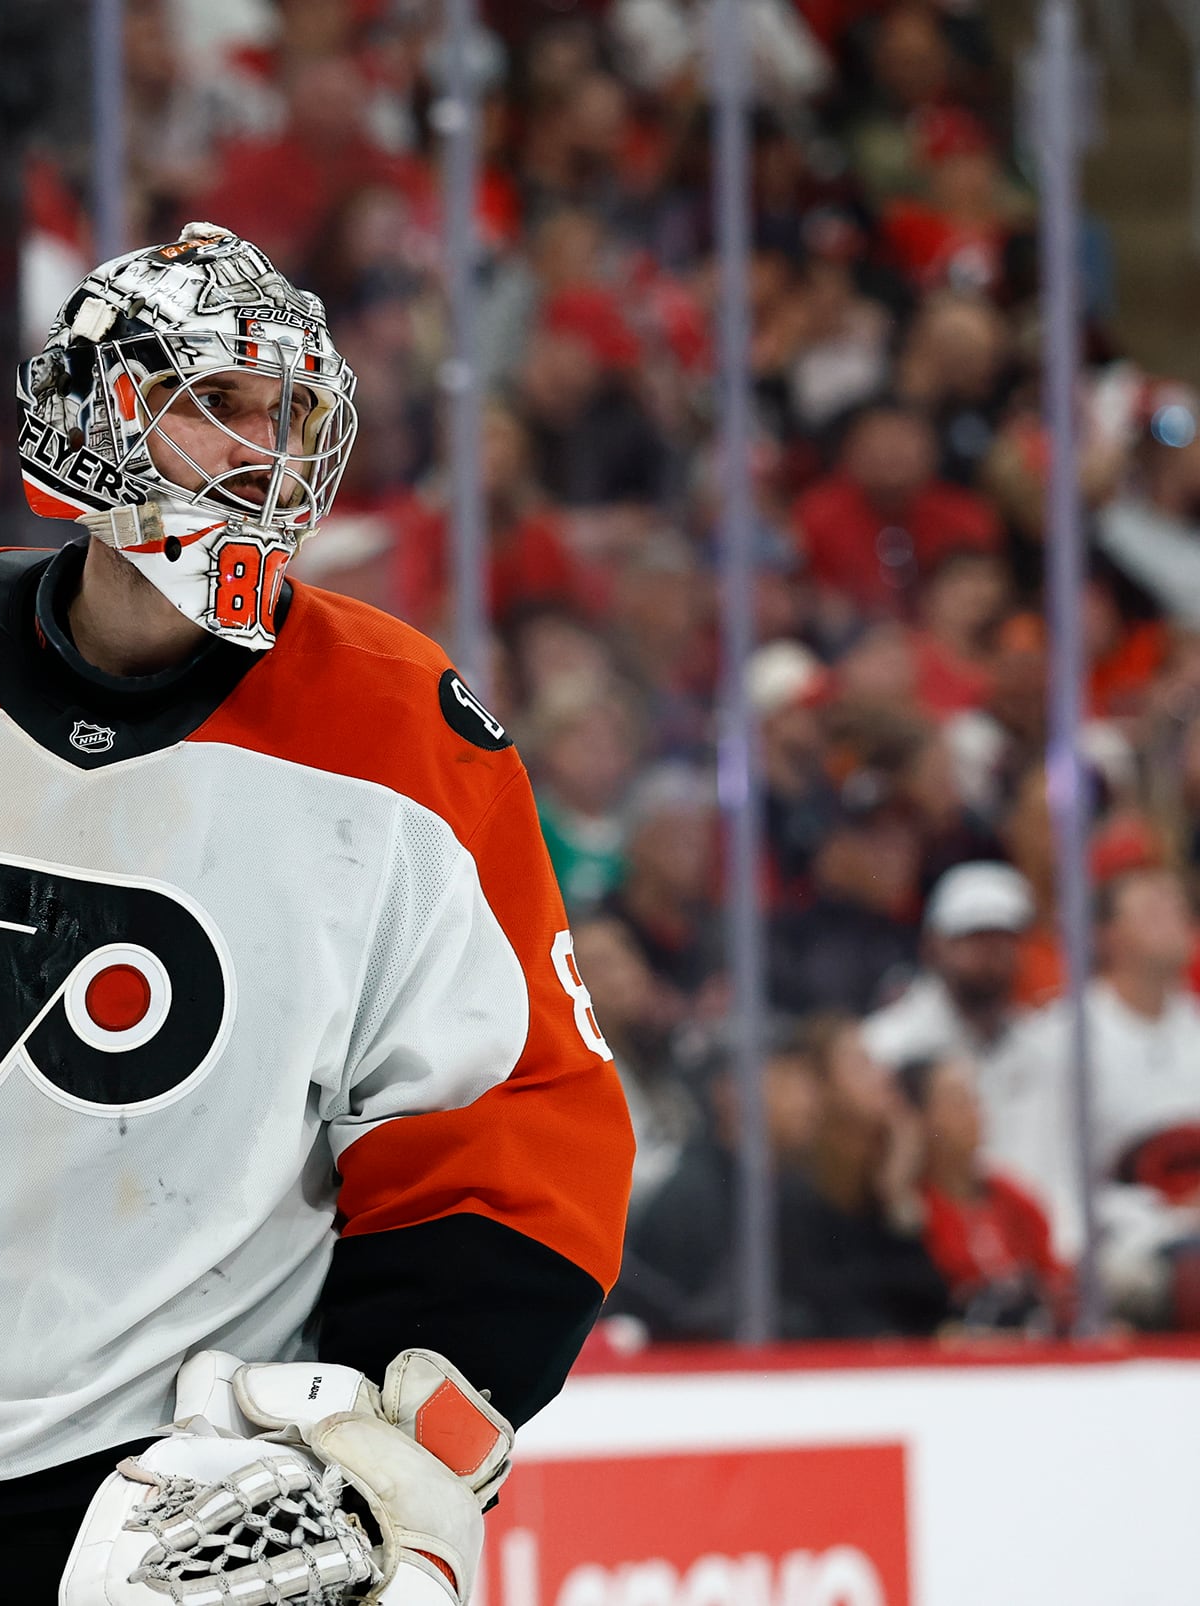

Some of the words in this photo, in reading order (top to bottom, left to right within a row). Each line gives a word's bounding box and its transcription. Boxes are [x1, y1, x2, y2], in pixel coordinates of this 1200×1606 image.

[18, 408, 151, 506] FLYERS
[211, 537, 292, 641] 80
[79, 733, 106, 745] NHL
